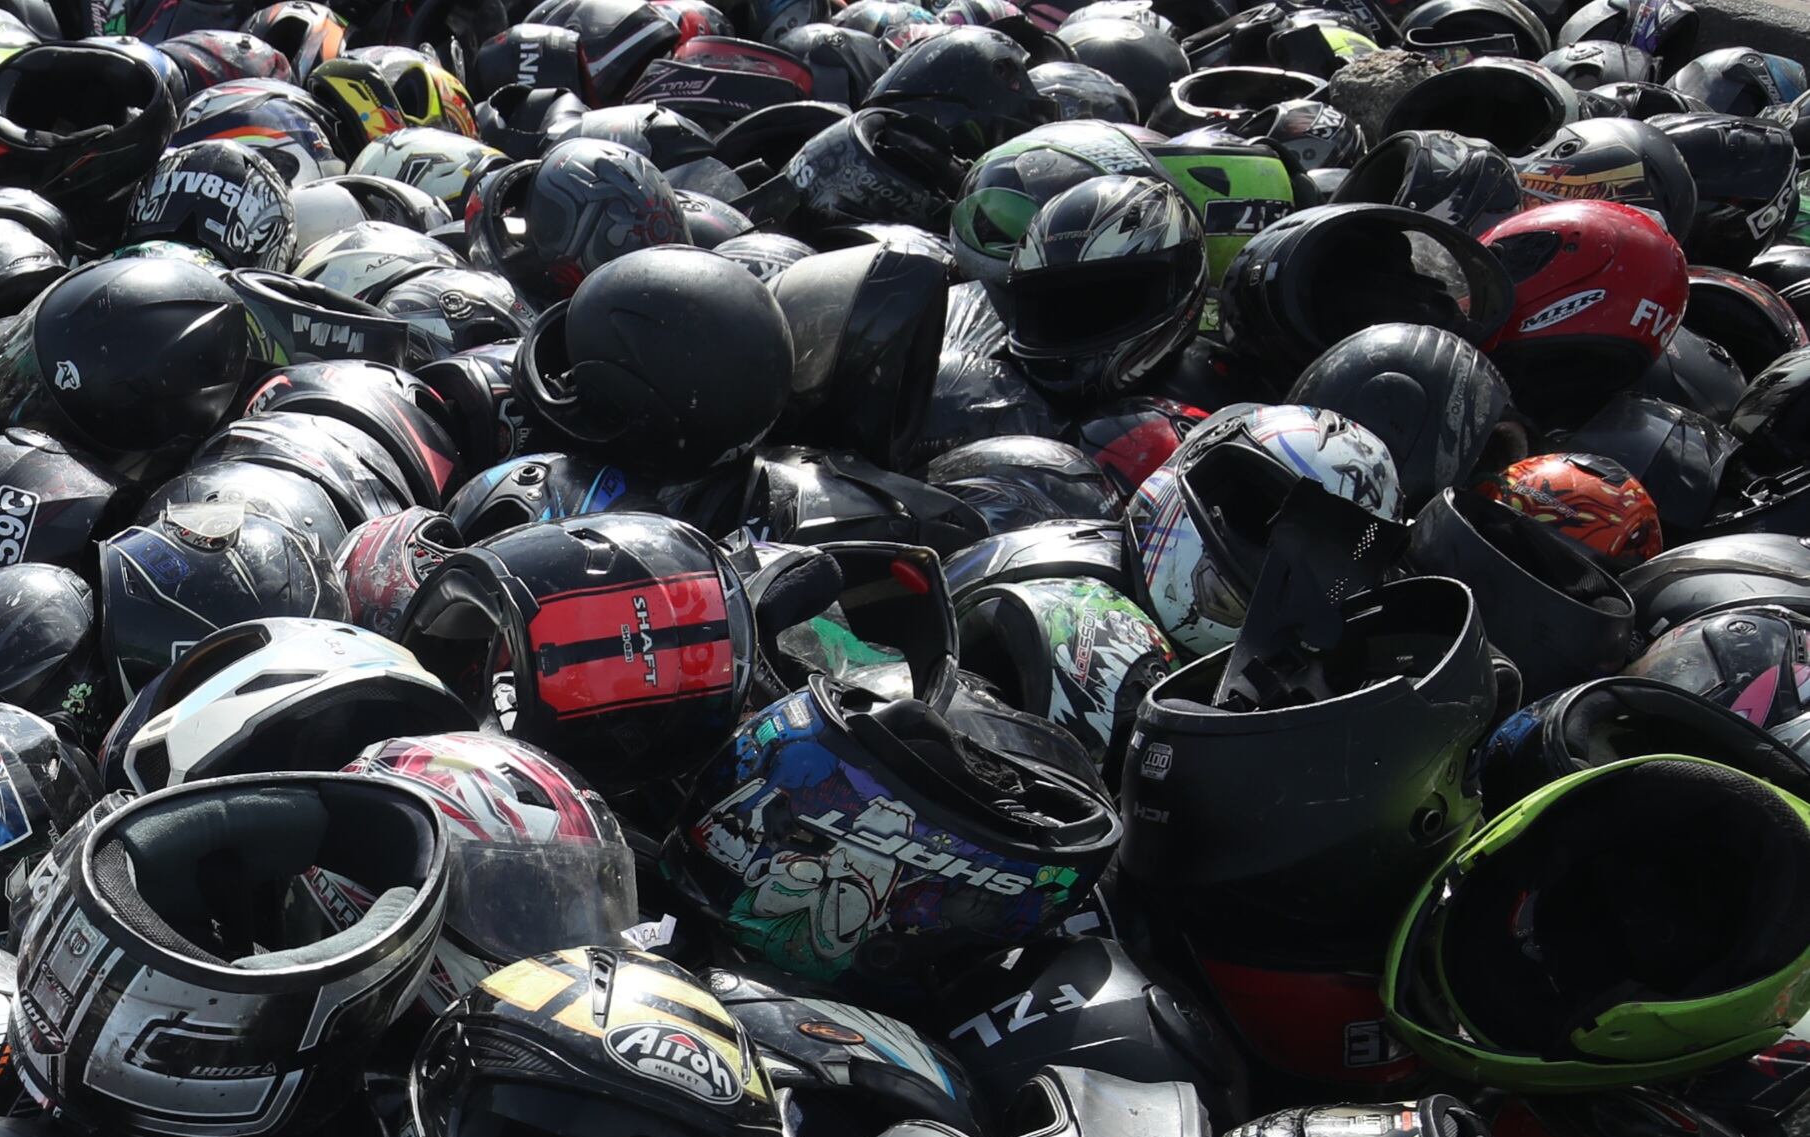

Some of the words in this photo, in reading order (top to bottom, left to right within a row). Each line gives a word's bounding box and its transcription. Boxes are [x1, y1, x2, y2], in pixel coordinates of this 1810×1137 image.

[1523, 290, 1600, 331] MHR
[631, 596, 659, 688] SHAFT
[1073, 606, 1098, 688] VOSSDOT
[798, 808, 1034, 896] SHAFT
[617, 1028, 736, 1098] Airoh
[653, 1062, 701, 1087] HELMET
